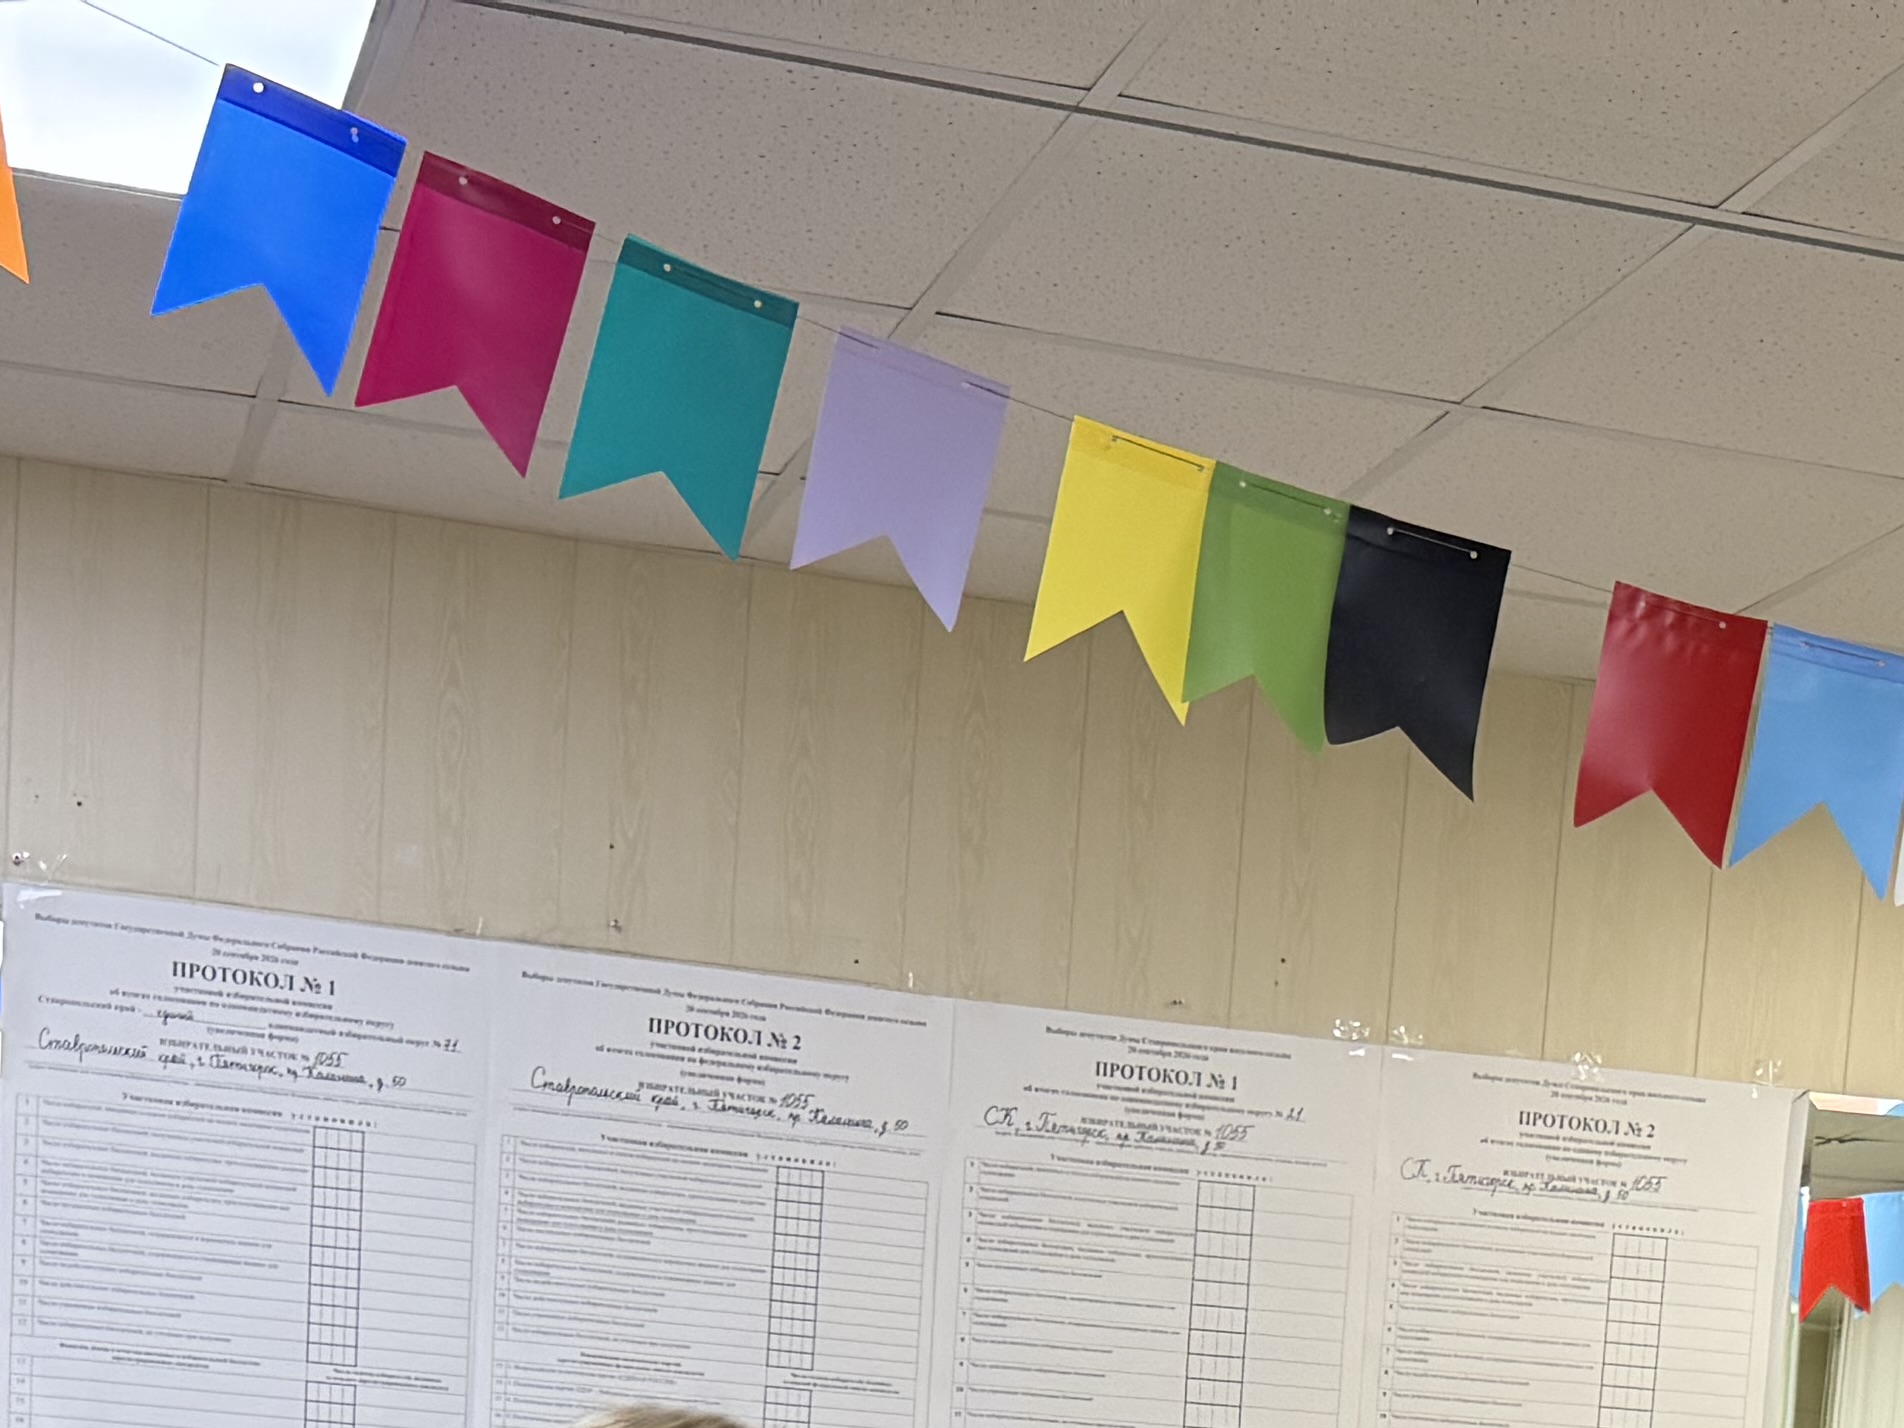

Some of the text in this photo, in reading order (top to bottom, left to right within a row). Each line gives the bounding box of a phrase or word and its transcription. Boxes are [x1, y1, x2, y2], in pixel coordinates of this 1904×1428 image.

[172, 961, 335, 996] ПРОТОКОЛ № 1
[648, 1017, 801, 1050] ПРОТОКОЛ № 2
[1096, 1061, 1237, 1091] ПРОТОКОЛ № 1
[1518, 1110, 1655, 1138] ПРОТОКОЛ № 2
